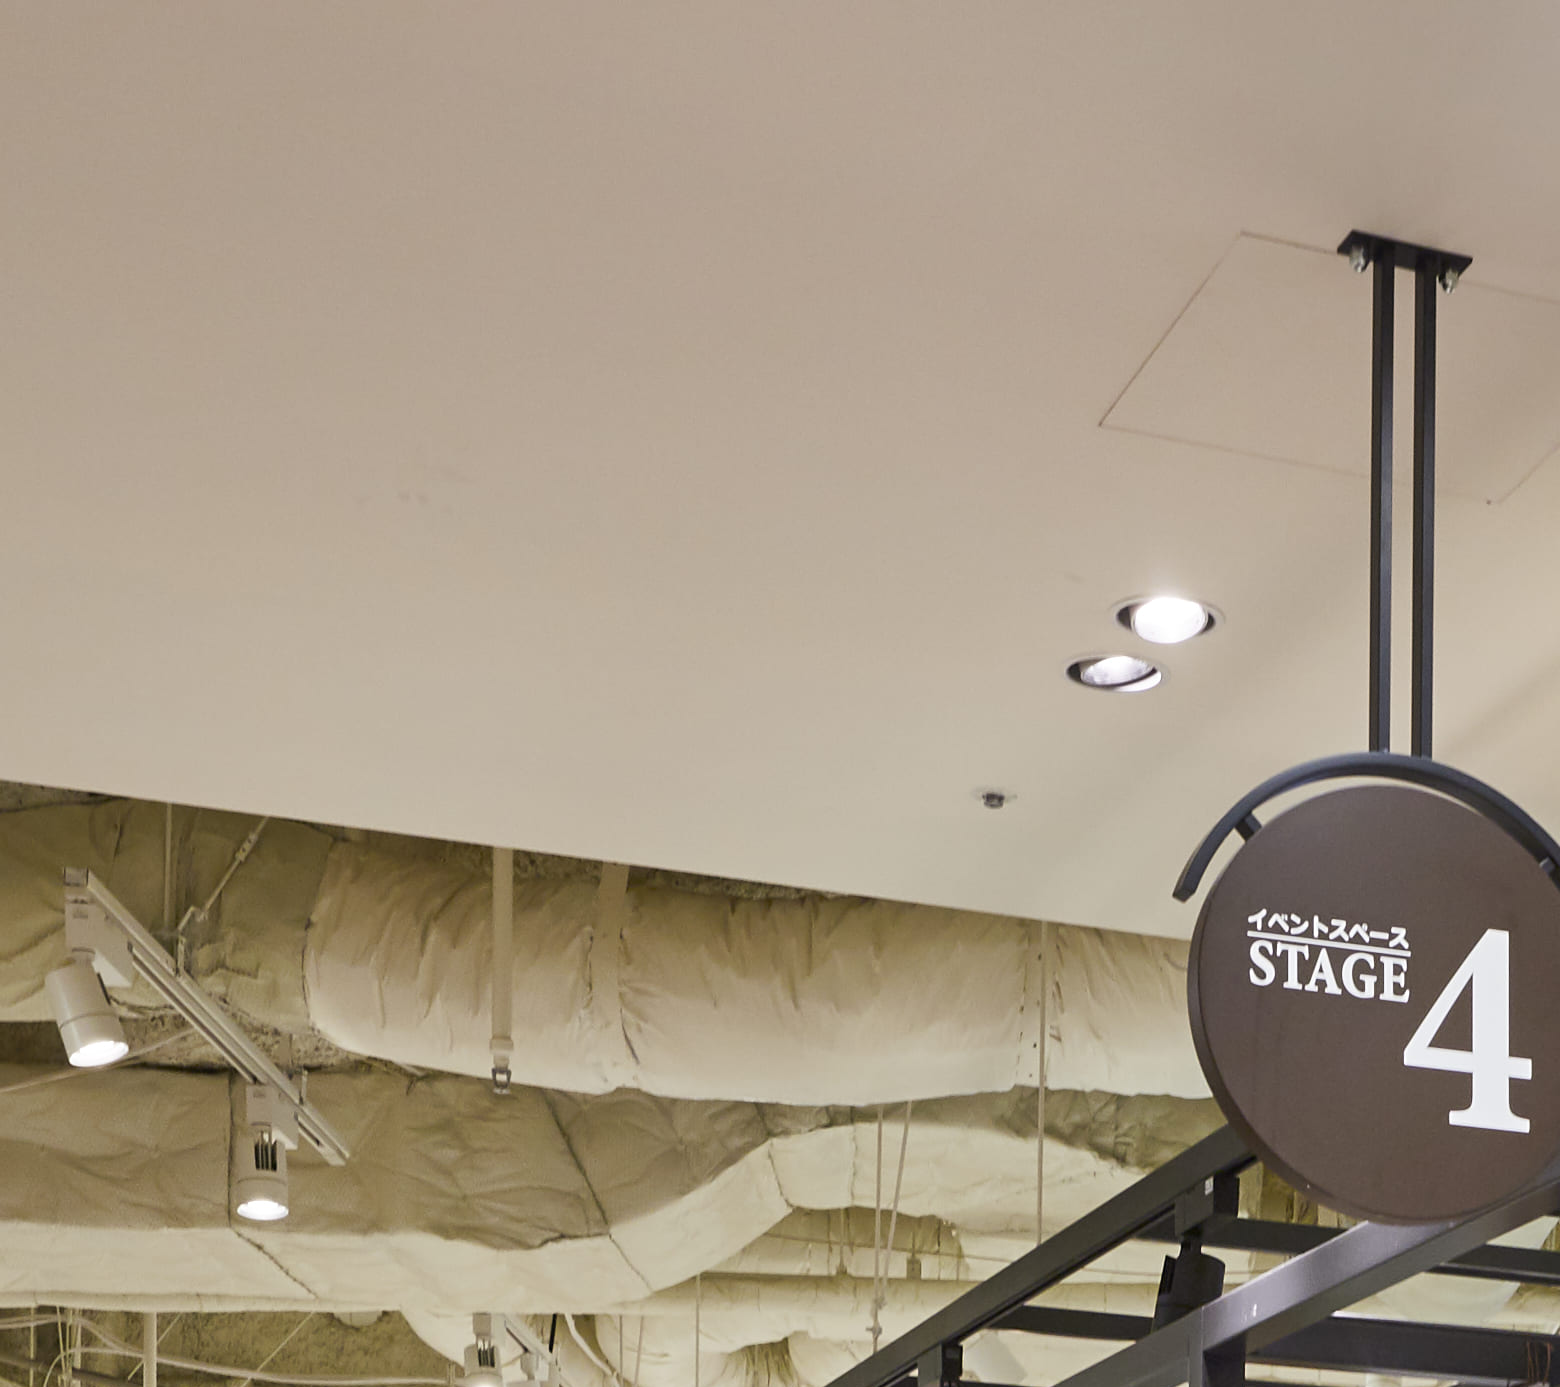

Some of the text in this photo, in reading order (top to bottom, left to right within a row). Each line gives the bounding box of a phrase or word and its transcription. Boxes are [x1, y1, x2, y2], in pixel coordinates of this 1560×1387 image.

[1247, 908, 1409, 950] イベントスペース
[1249, 939, 1410, 1003] STAGE
[1403, 928, 1532, 1133] 4
